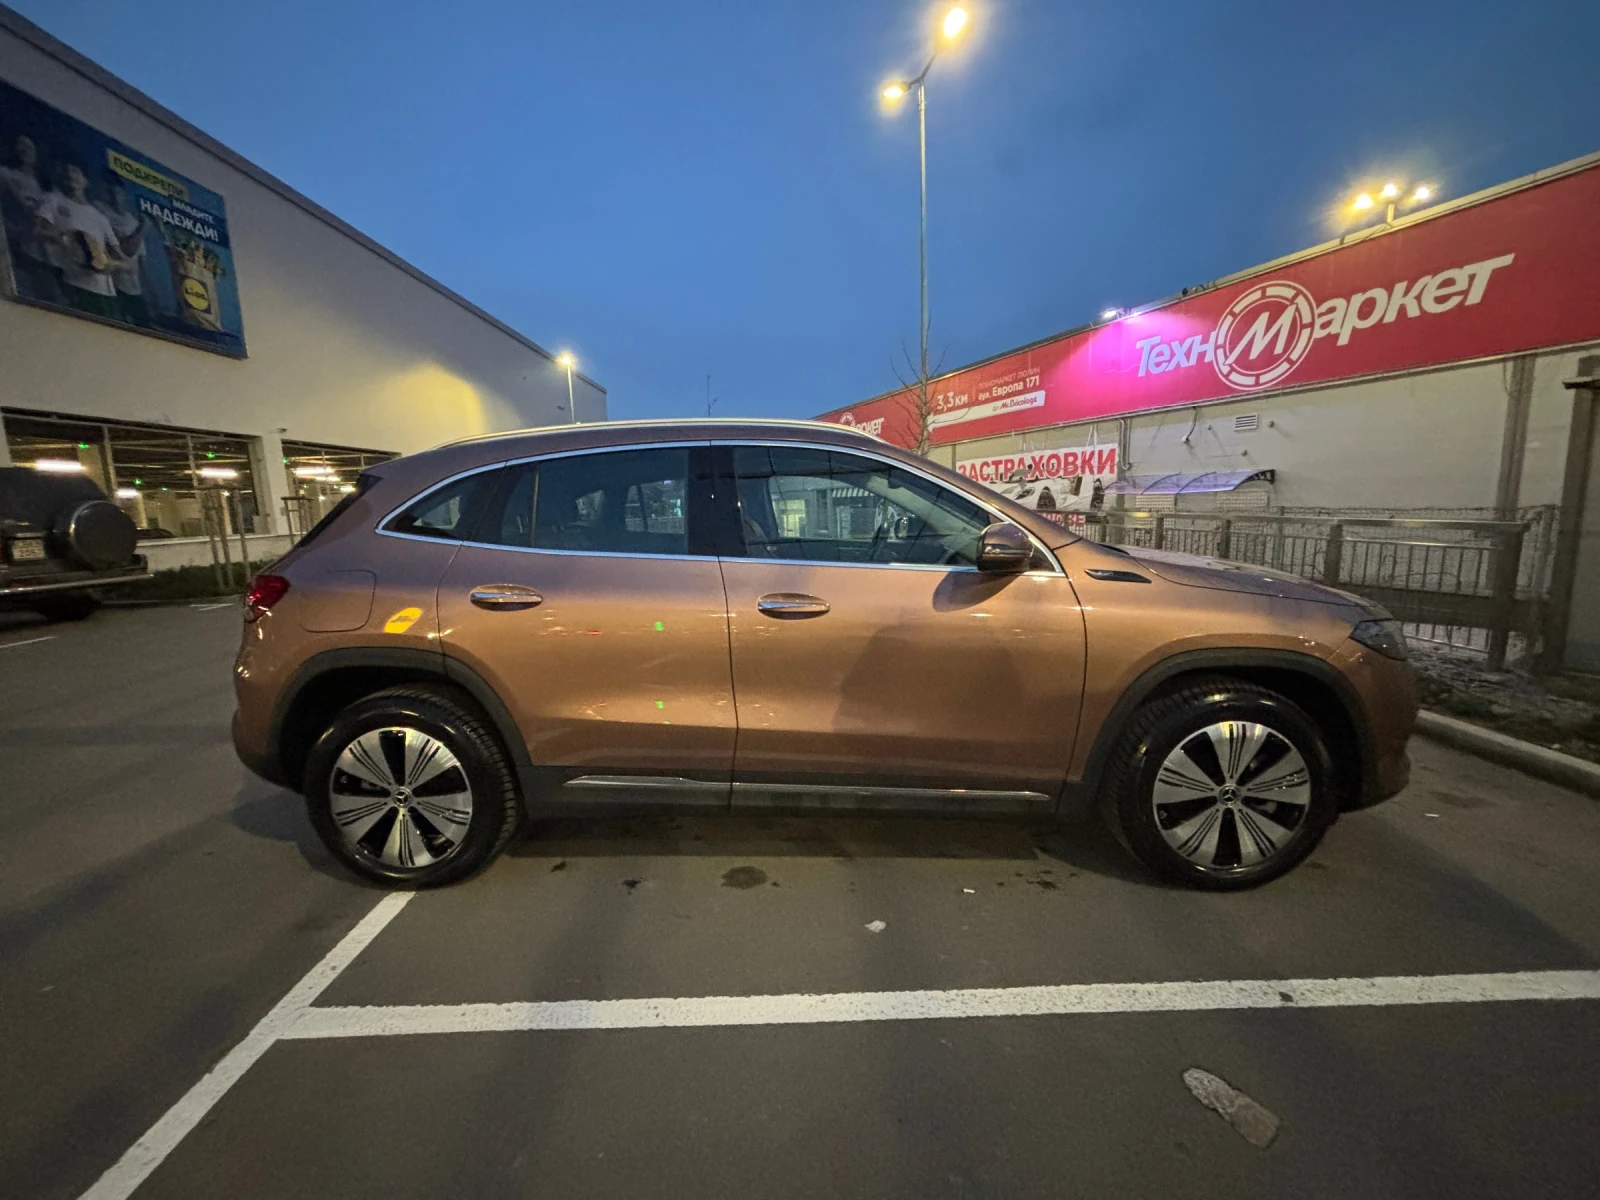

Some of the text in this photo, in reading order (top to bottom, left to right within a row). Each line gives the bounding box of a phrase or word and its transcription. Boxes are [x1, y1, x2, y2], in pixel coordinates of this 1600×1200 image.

[140, 197, 218, 241] НАДЕЖДИ!
[992, 381, 1024, 396] Европа
[1025, 375, 1040, 388] 171
[957, 448, 1117, 482] ЗАСТРАХОВКИ
